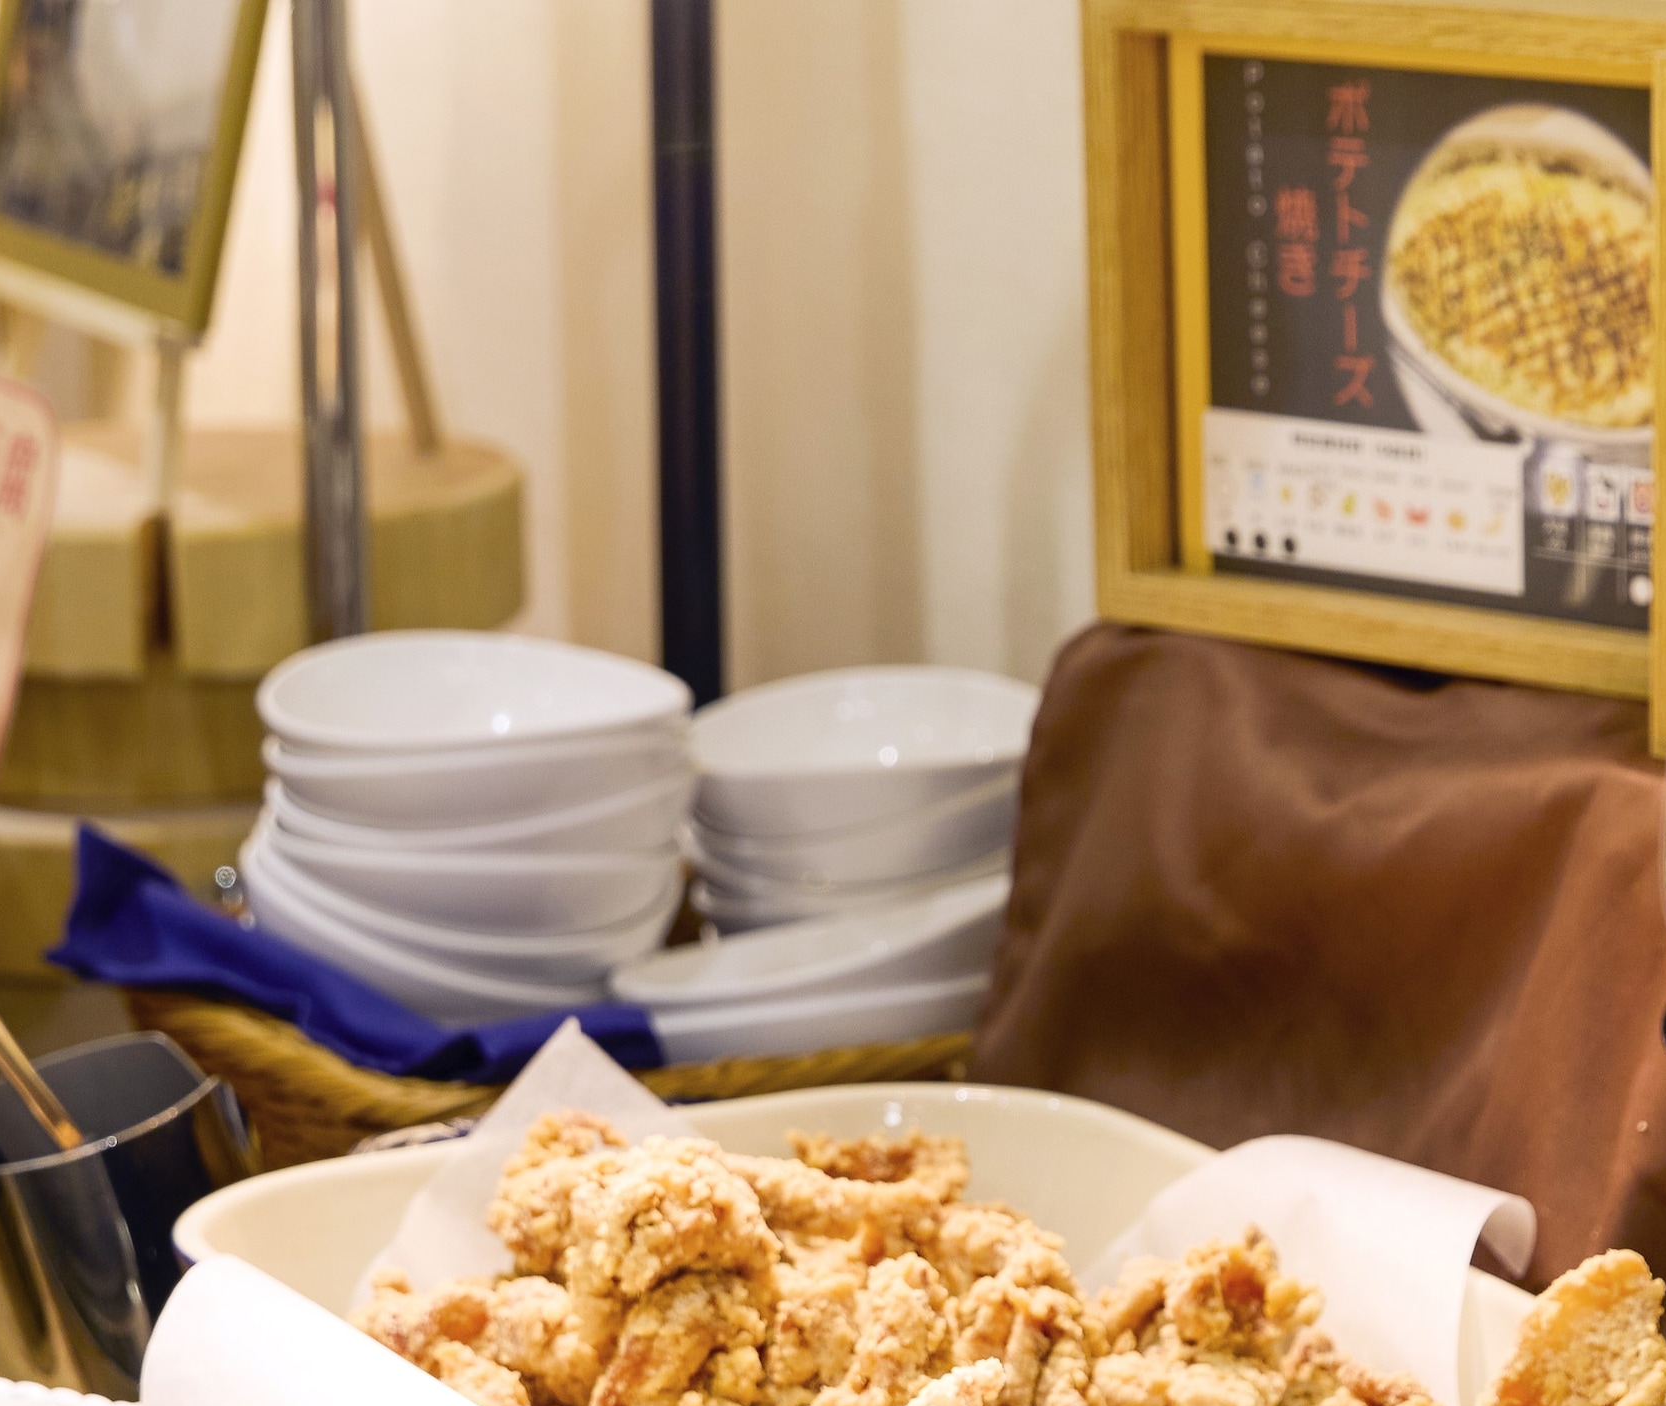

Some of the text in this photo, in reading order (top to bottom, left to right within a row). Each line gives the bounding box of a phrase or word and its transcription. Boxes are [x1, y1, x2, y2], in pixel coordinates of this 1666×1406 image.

[1327, 79, 1376, 408] ポテトチーズ
